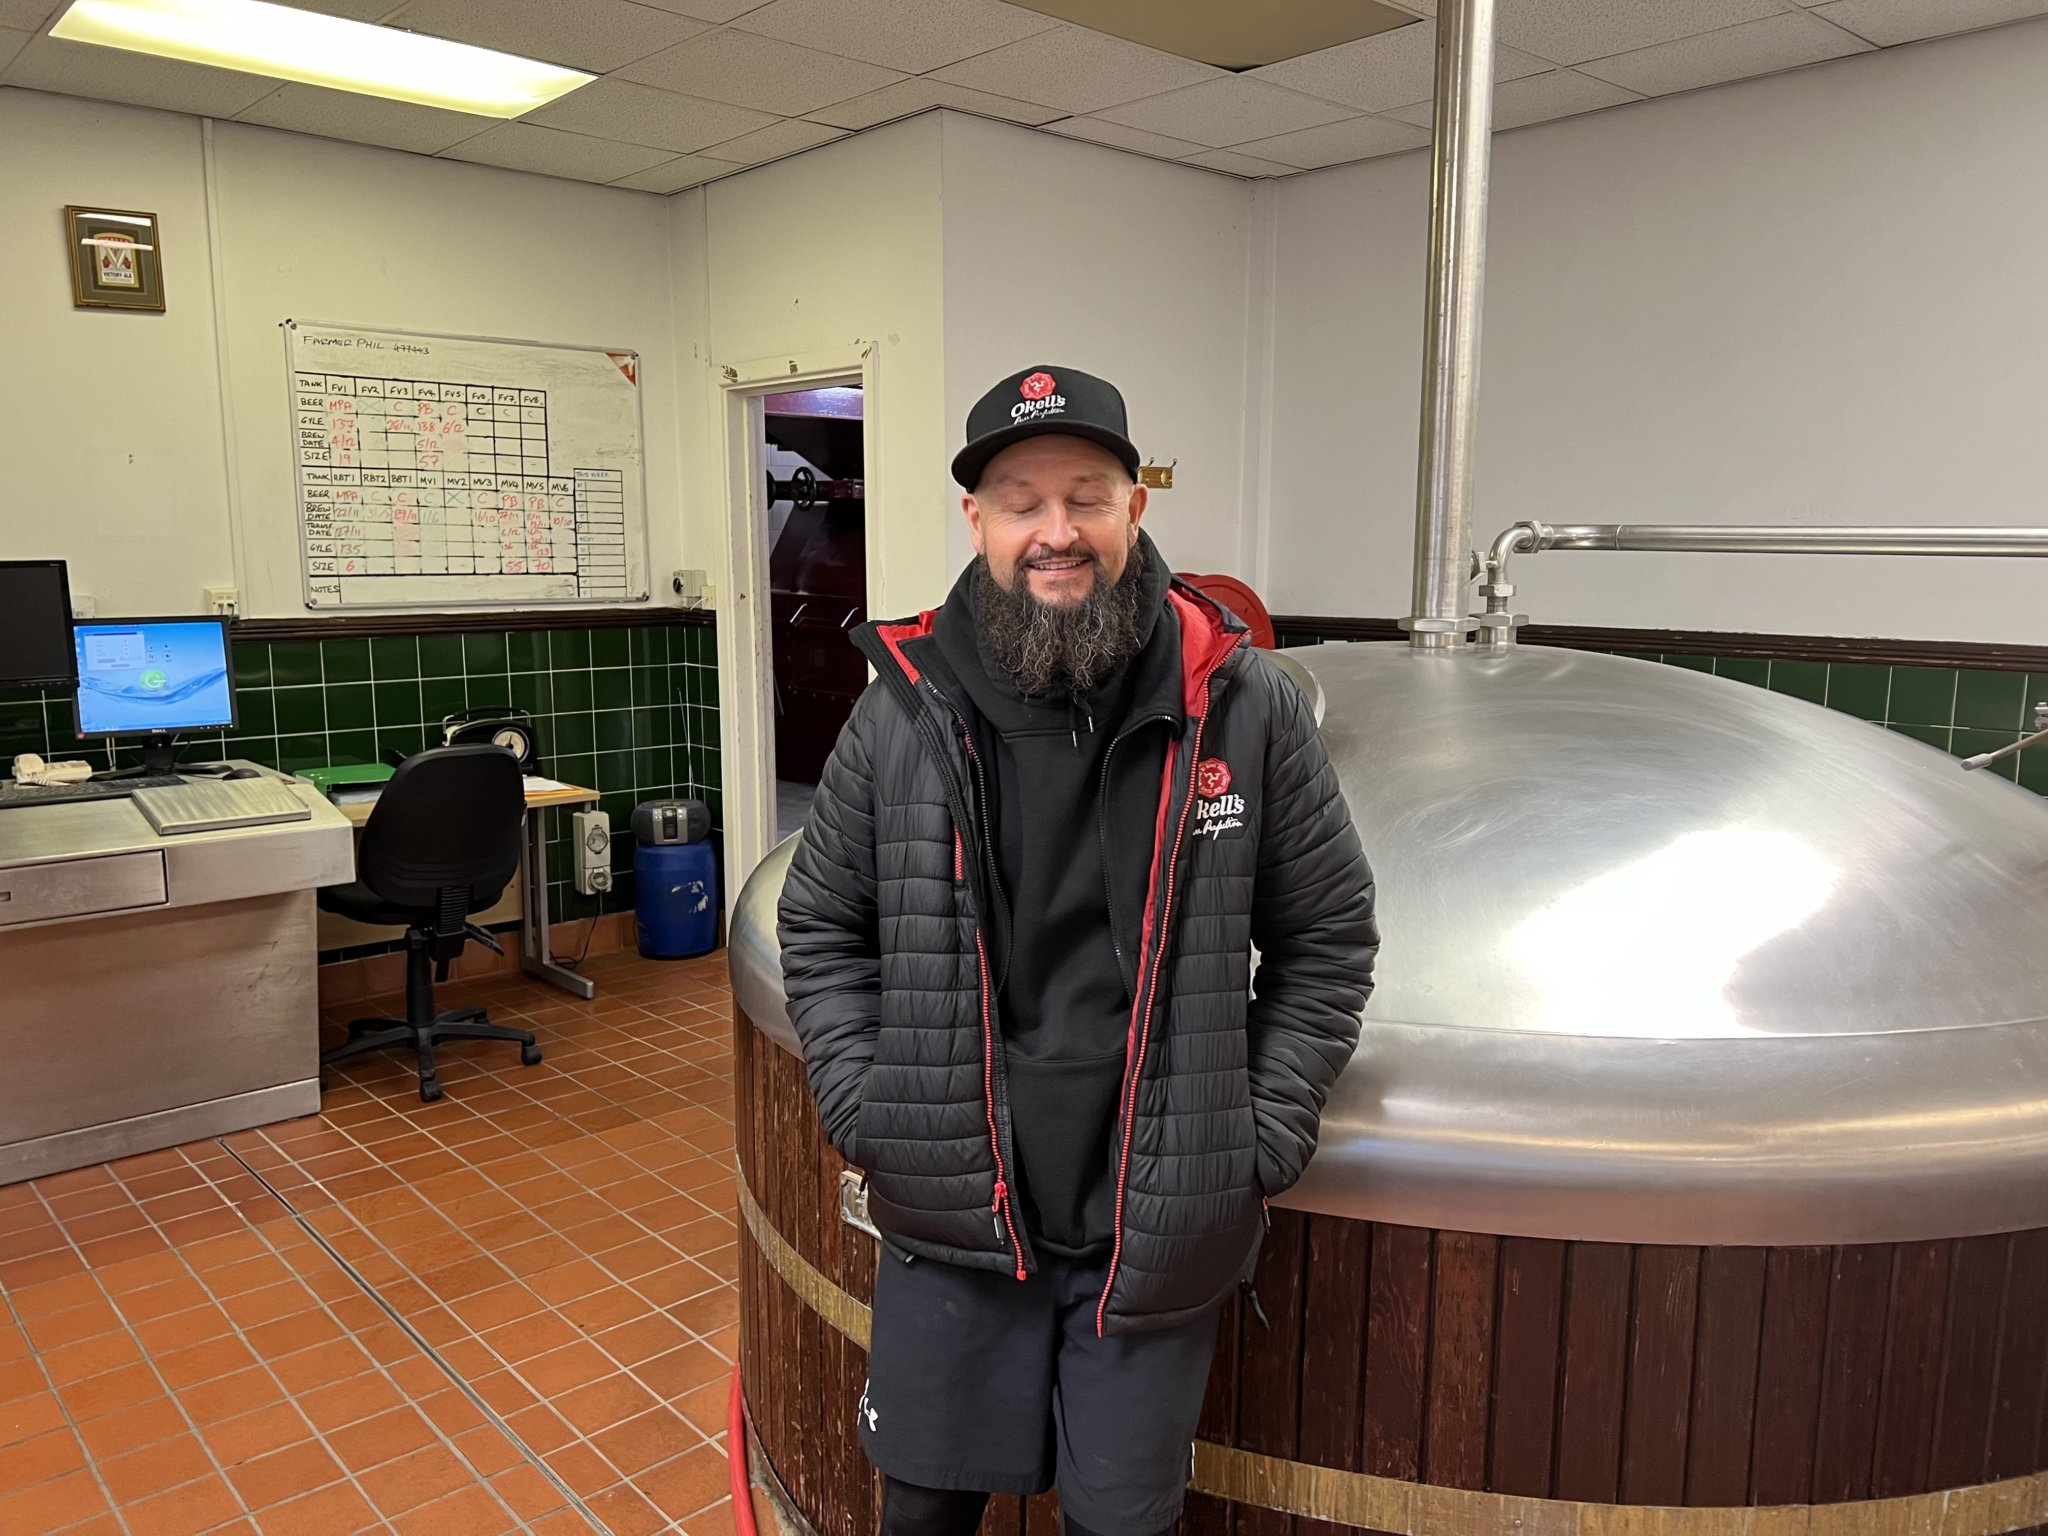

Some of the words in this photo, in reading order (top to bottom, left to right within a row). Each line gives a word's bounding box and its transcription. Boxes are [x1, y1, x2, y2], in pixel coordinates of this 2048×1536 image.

[303, 335, 352, 346] FARMER
[356, 338, 384, 350] PHIL
[299, 379, 323, 388] TANK
[331, 384, 347, 392] FV1
[361, 386, 380, 394] FV2
[390, 386, 408, 395] FV3
[418, 389, 436, 397] FV4
[301, 398, 324, 407] BEER
[329, 399, 352, 411] MPA
[393, 401, 403, 412] C
[417, 402, 434, 414] PB
[447, 405, 458, 416] C
[476, 407, 486, 415] C
[1011, 394, 1066, 418] Okell's
[301, 417, 324, 426] GYLE
[417, 420, 436, 432] 138
[301, 431, 325, 440] BREW
[302, 439, 324, 448] DATE
[331, 435, 356, 447] 4/12
[417, 438, 439, 449] 5/12
[304, 450, 329, 461] SIZE
[339, 453, 351, 465] 19
[418, 455, 439, 468] 57
[306, 473, 331, 481] TANK
[333, 473, 355, 482] RBT1
[363, 473, 387, 483] RBT2
[391, 474, 412, 484] BBT1
[420, 477, 436, 485] MV1
[447, 478, 468, 486] MV2
[473, 478, 493, 486] MV3
[500, 480, 519, 490] MV4
[525, 482, 545, 491] MV5
[551, 483, 569, 493] MV6
[307, 490, 331, 499] BEER
[336, 490, 358, 500] MPA
[397, 492, 407, 503] C
[477, 492, 488, 504] C
[501, 494, 518, 508] PB
[528, 496, 545, 510] PB
[555, 497, 565, 507] C
[306, 504, 331, 513] BREW
[310, 544, 333, 553] GYLE
[341, 544, 362, 555] 135
[312, 562, 334, 571] SIZE
[346, 560, 355, 572] 6
[505, 560, 524, 572] 55
[532, 559, 551, 571] 70
[310, 585, 340, 593] NOTES
[1197, 794, 1245, 820] kell's
